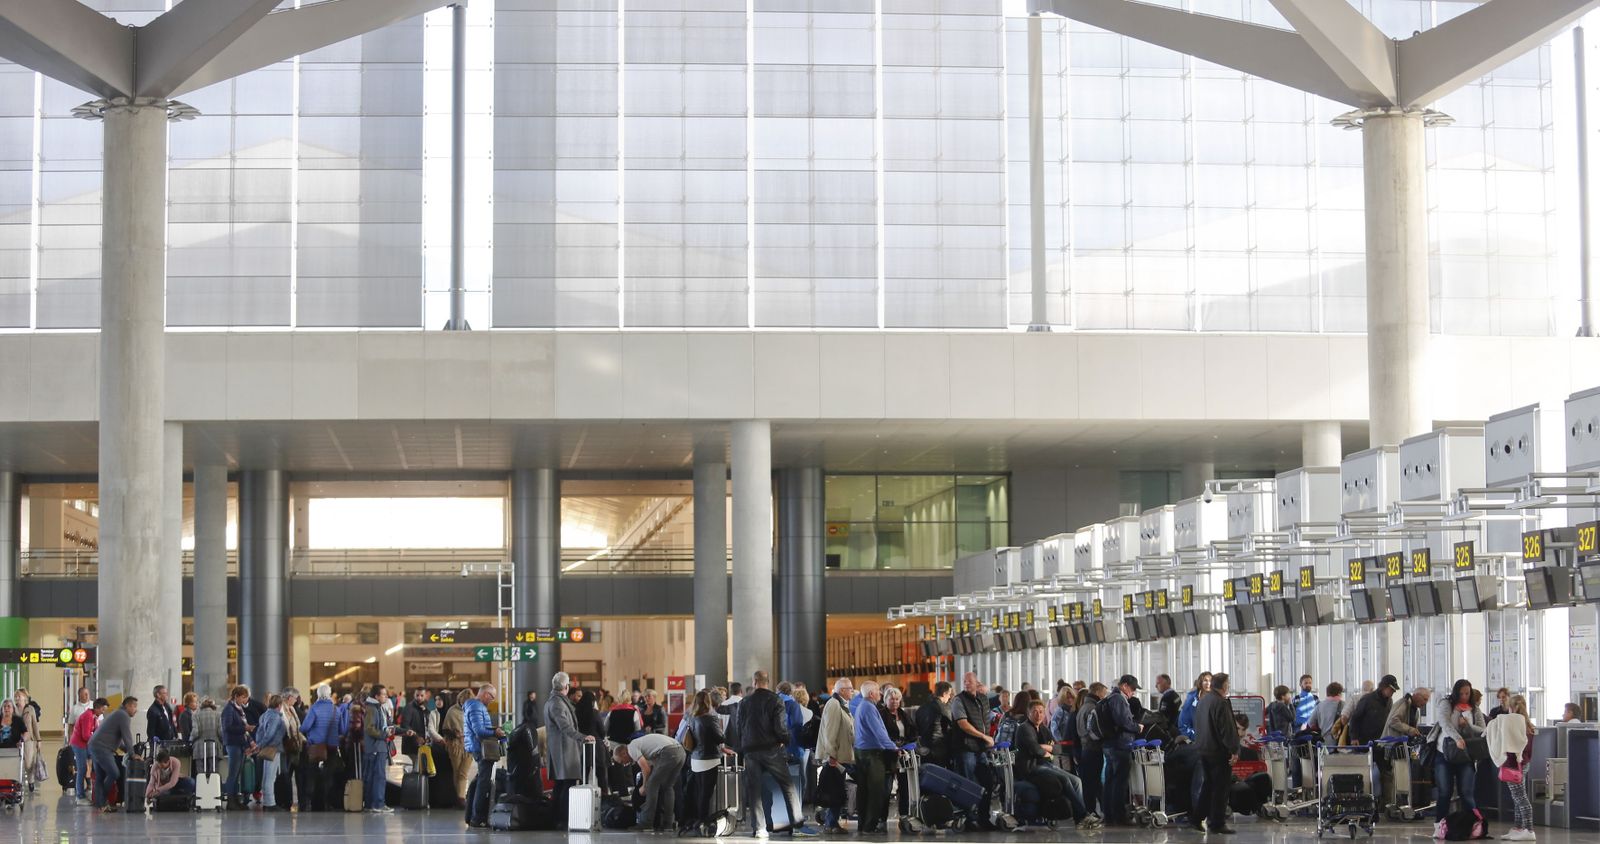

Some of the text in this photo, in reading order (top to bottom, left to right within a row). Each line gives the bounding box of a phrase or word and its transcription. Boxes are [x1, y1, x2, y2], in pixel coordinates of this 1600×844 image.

[1525, 536, 1541, 558] 326
[1579, 527, 1596, 551] 327
[1413, 554, 1427, 573] 324
[1456, 546, 1470, 567] 325
[1350, 562, 1362, 581] 322
[1387, 557, 1400, 576] 323
[1251, 577, 1261, 593] 319
[1270, 574, 1281, 591] 320
[1301, 570, 1312, 587] 321
[557, 631, 567, 639] T1
[572, 631, 584, 639] T2
